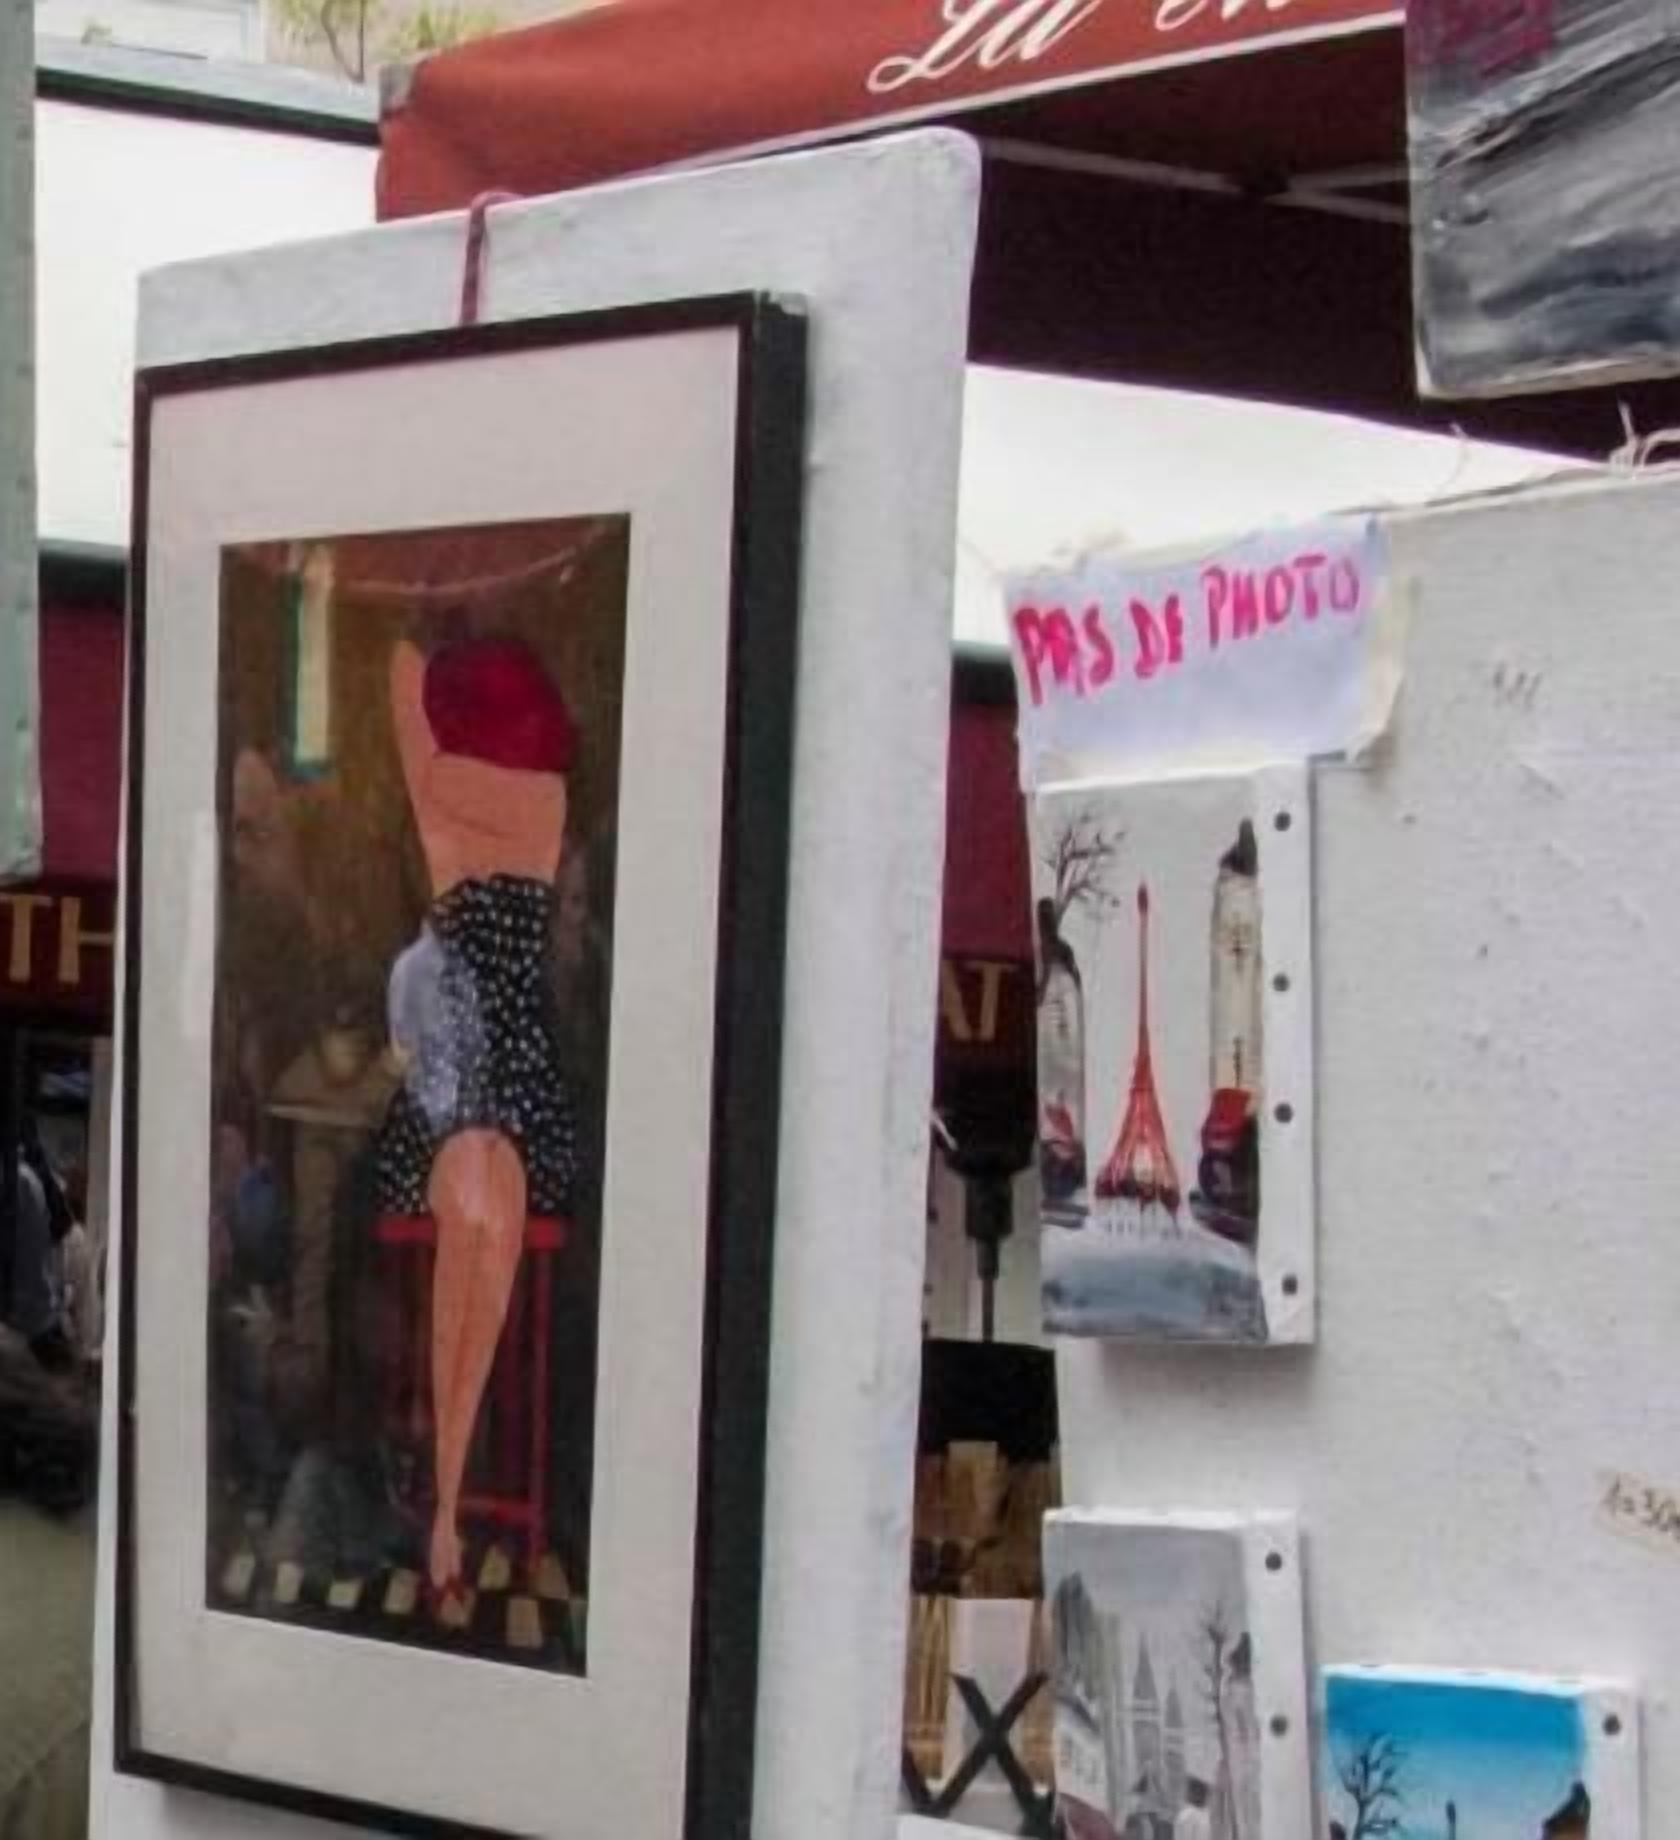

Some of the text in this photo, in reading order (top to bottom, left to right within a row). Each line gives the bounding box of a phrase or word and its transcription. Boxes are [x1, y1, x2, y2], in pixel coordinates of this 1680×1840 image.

[1014, 550, 1362, 708] PAS DE PHOTO
